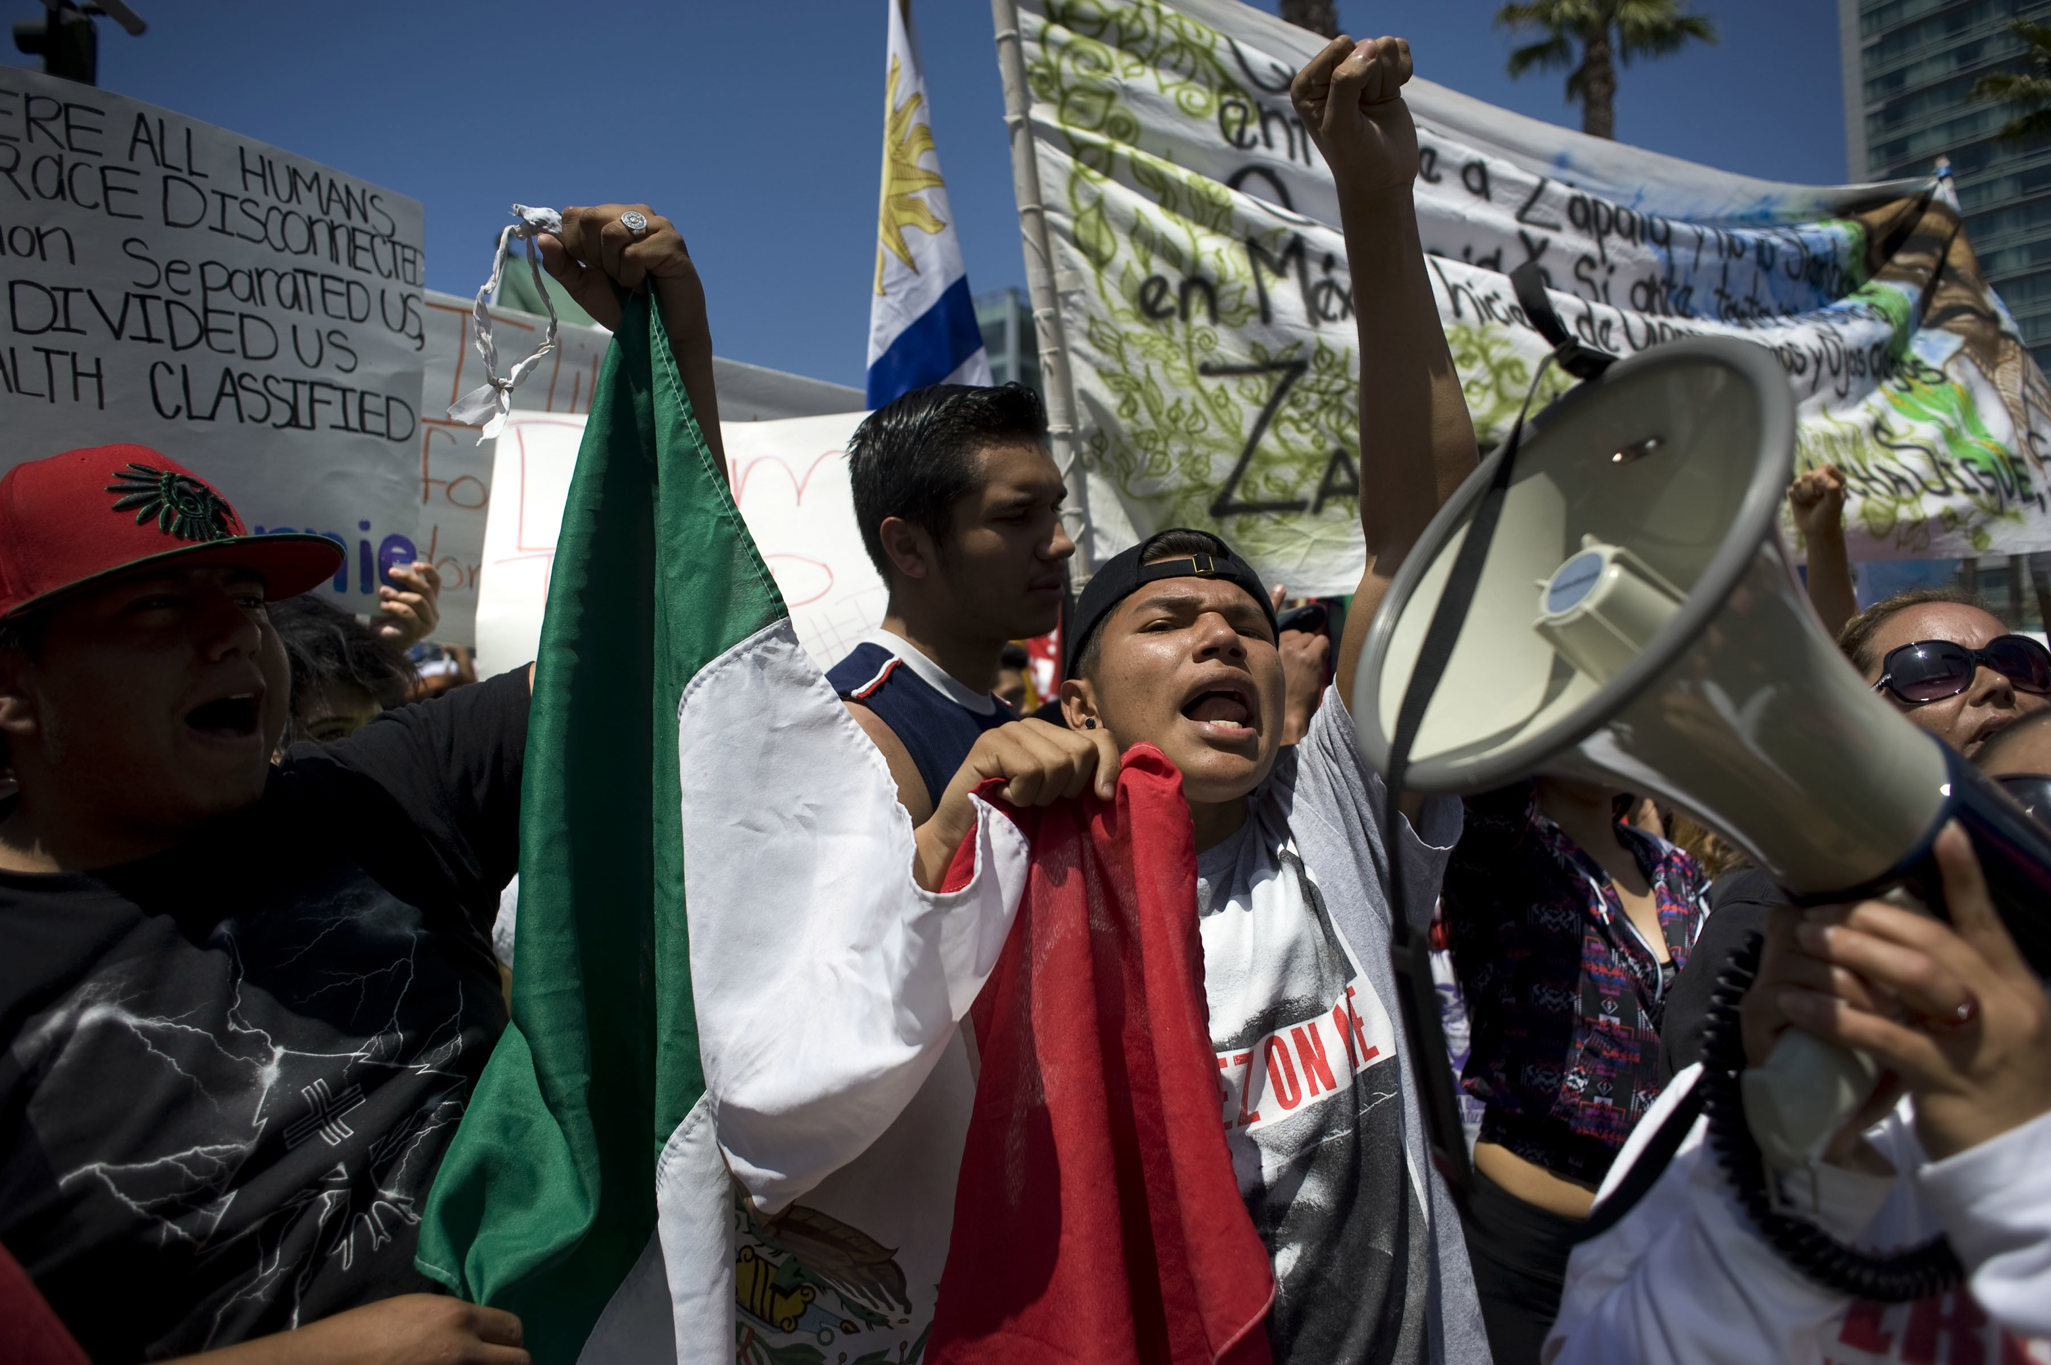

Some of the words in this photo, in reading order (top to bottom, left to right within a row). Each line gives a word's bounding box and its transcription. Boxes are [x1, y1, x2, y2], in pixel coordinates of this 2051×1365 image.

[129, 112, 209, 178] ALL
[238, 145, 396, 238] HUMANS
[8, 279, 279, 360] DIVIDED
[291, 323, 359, 374] US
[1137, 273, 1219, 325] en
[149, 361, 416, 443] CLASSIFIED
